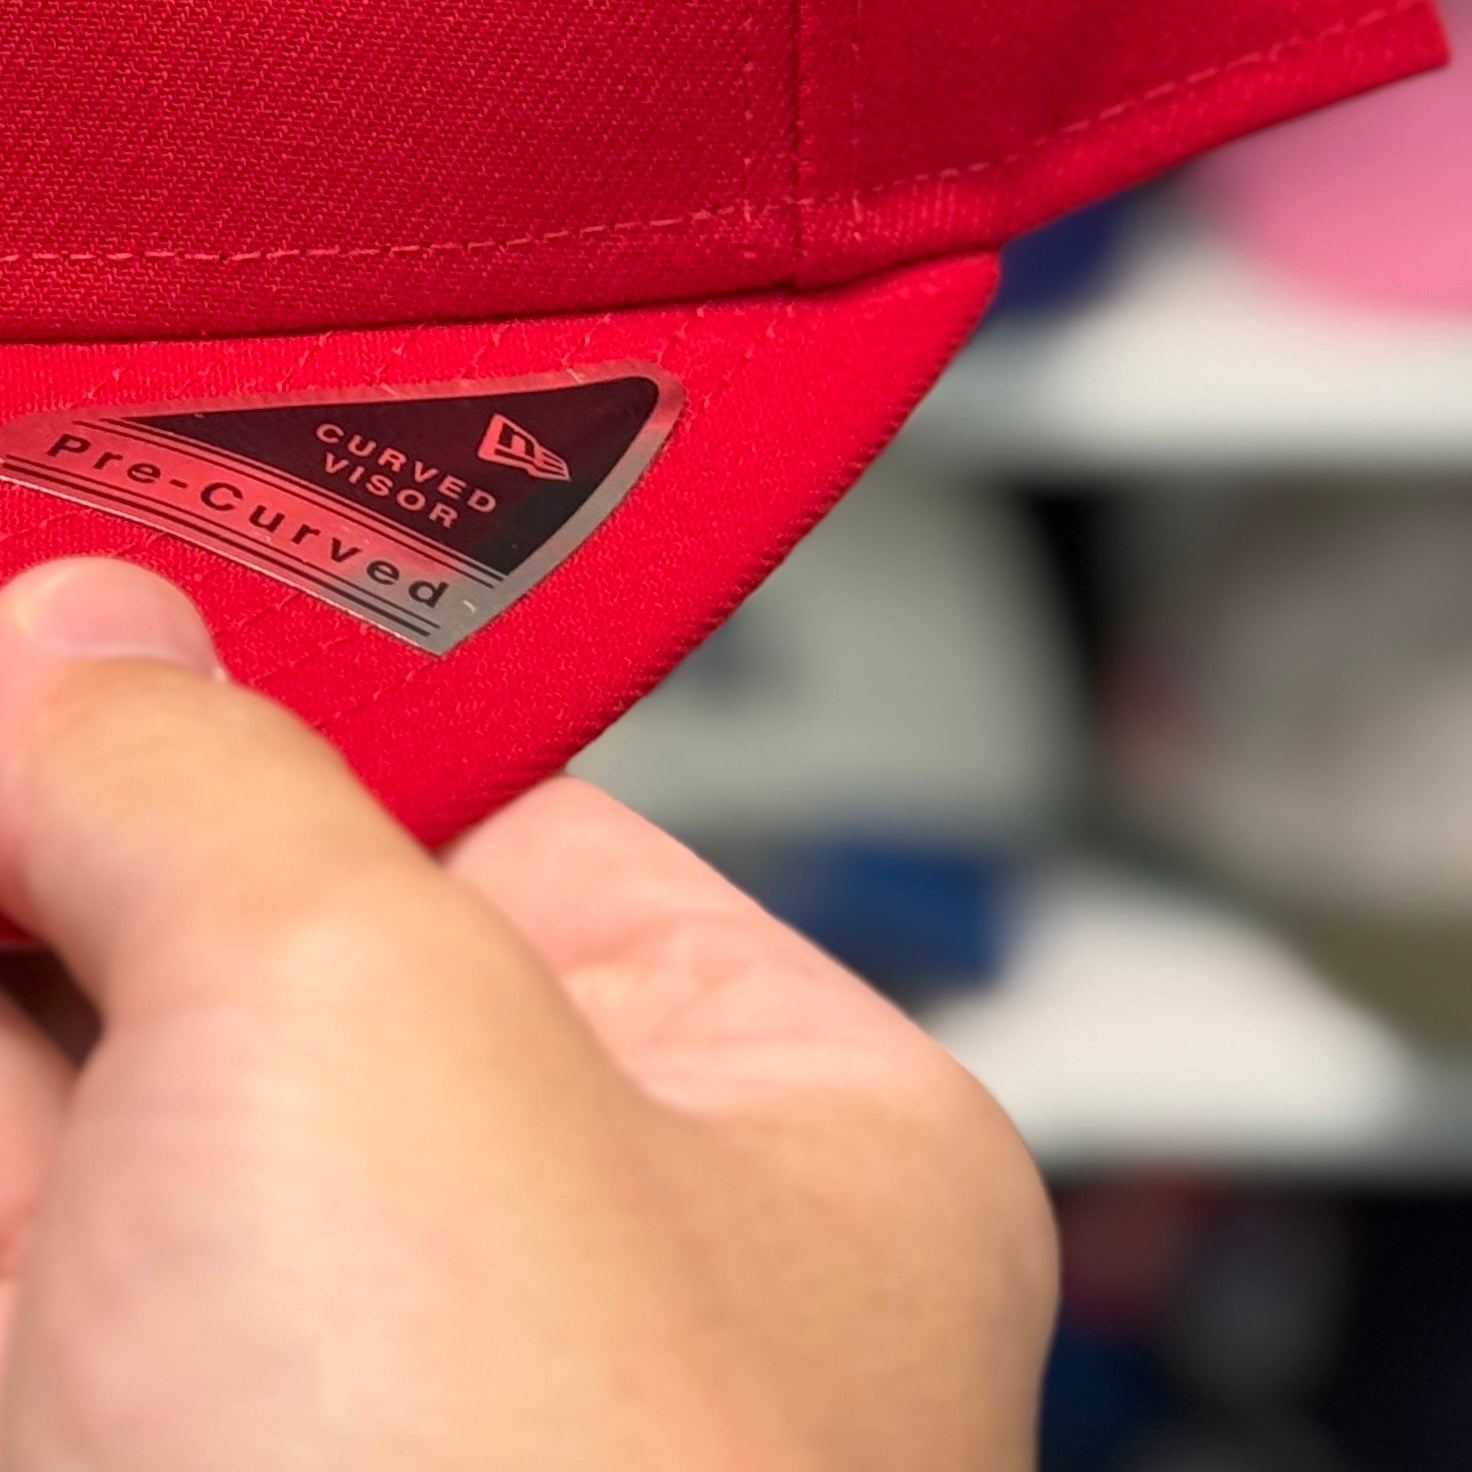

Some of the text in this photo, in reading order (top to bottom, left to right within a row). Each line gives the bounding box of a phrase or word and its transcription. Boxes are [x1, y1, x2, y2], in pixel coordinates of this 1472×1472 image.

[316, 423, 496, 513] CURVED
[325, 452, 458, 528] VISOR
[46, 433, 449, 608] Pre-Curved
